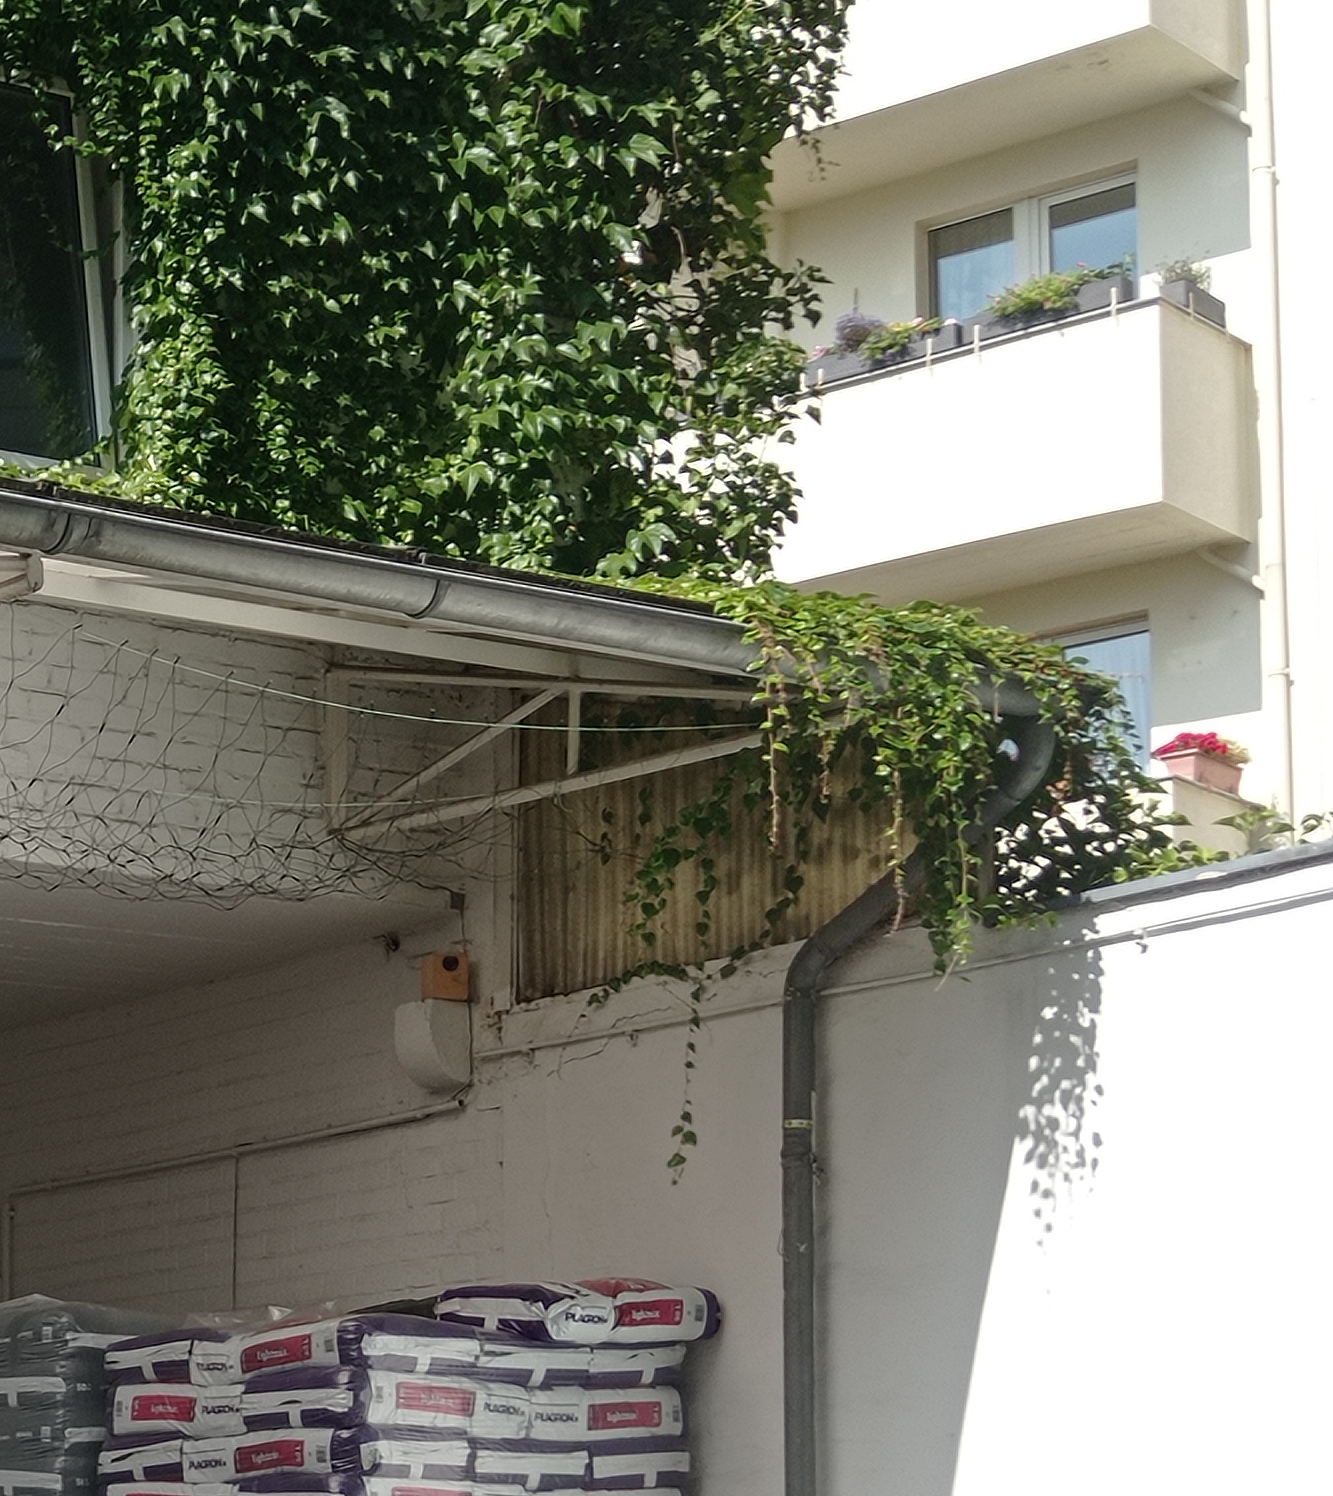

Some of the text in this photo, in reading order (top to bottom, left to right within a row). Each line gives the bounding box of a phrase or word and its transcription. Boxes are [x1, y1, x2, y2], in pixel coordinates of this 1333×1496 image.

[565, 1311, 605, 1324] PLAGRON
[534, 1412, 574, 1422] PLAGRON
[188, 1459, 223, 1470] PLAGRON
